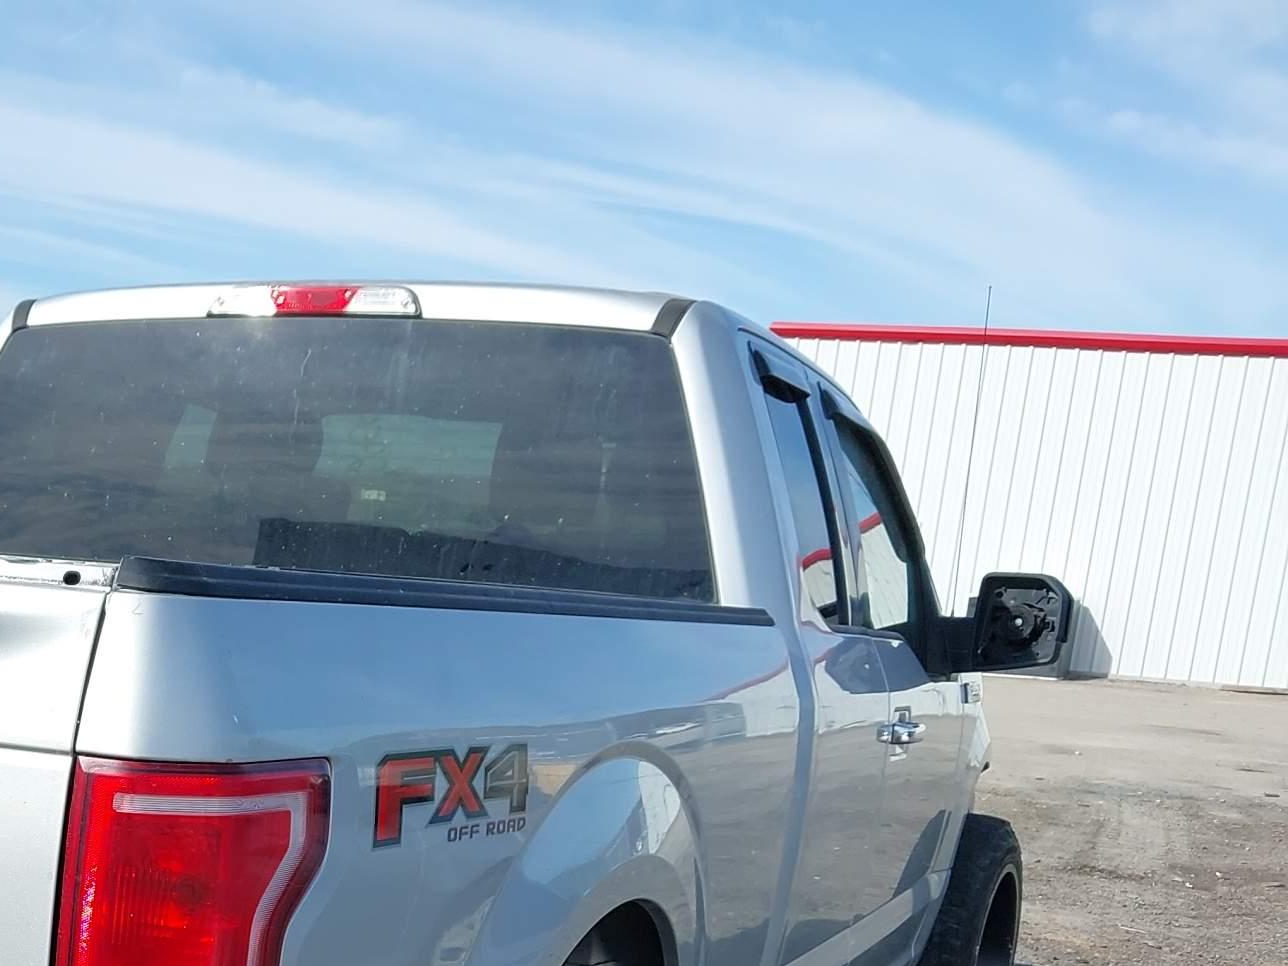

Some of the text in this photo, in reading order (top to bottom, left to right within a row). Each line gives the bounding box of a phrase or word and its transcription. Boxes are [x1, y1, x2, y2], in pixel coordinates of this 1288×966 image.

[372, 743, 529, 848] FX4
[447, 817, 527, 843] OFF ROAD
